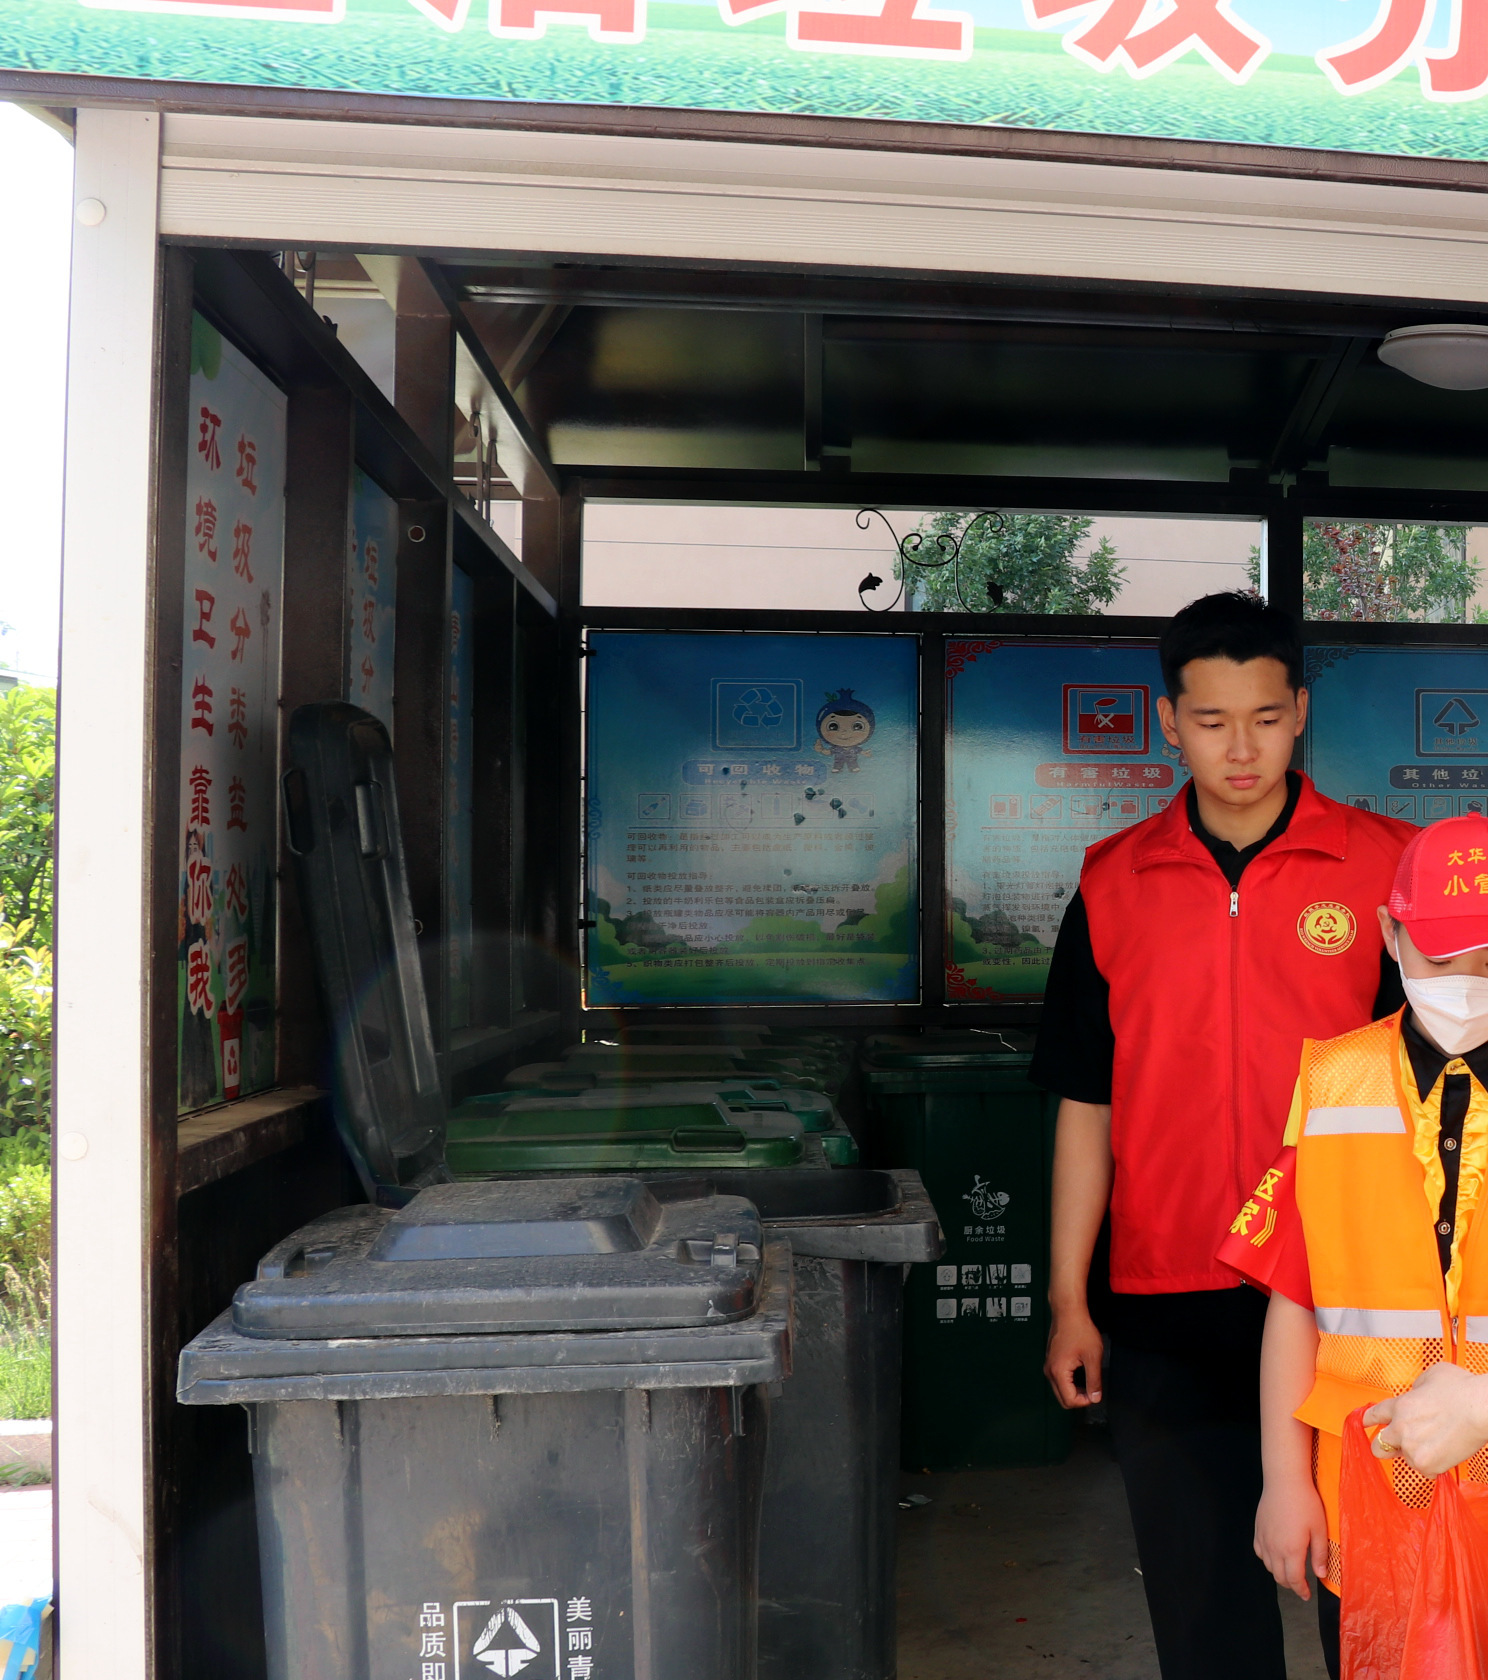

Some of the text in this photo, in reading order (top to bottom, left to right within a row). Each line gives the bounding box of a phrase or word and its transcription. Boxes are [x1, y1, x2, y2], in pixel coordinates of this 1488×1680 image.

[362, 540, 378, 711] 垃圾分
[189, 406, 222, 1010] 环境卫生靠你我
[227, 434, 258, 1007] 垃圾分类益处多
[697, 763, 815, 776] 可回收物
[1049, 766, 1162, 779] 有害垃圾
[963, 1225, 1006, 1235] 厨余垃圾
[419, 1602, 447, 1680] 品质即
[566, 1596, 594, 1680] 美丽青
